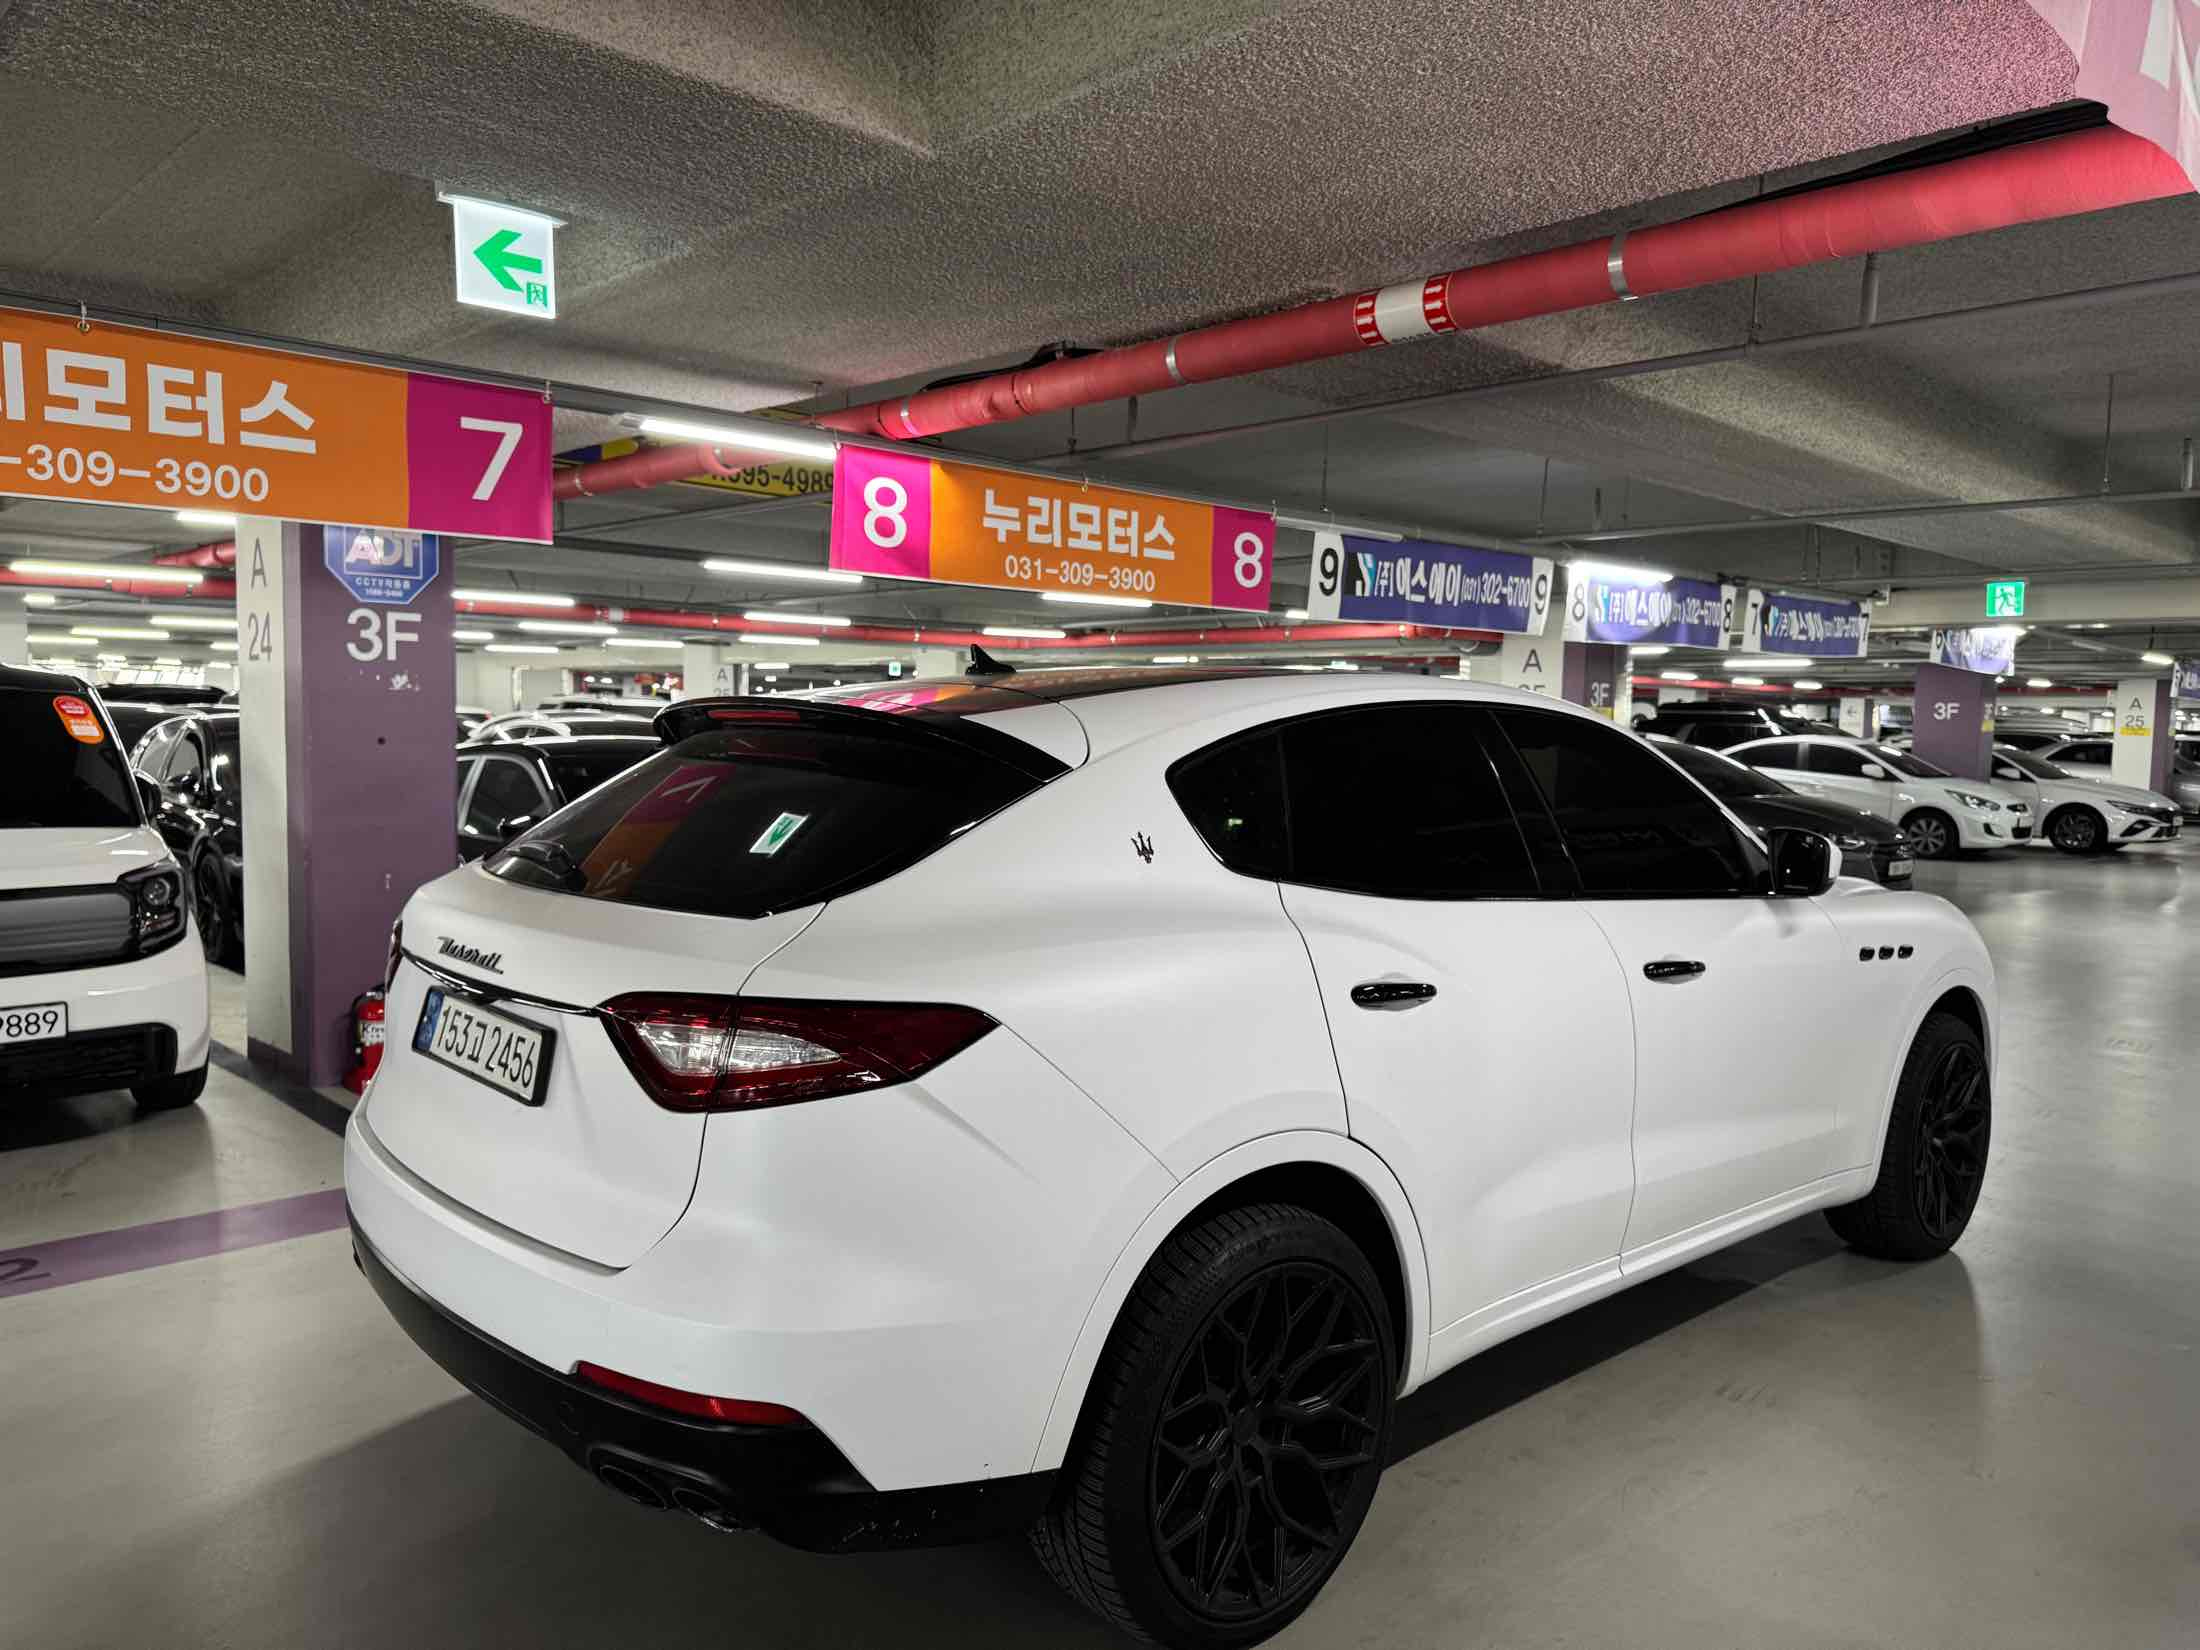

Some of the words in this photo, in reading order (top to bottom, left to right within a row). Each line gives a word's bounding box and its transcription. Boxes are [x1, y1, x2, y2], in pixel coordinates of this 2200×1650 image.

[460, 416, 524, 501] 7
[863, 476, 908, 548] 8
[982, 488, 1176, 561] 누리모터스
[1233, 531, 1264, 588] 8
[250, 537, 268, 590] A
[1004, 554, 1156, 592] 031-309-3900
[1319, 547, 1339, 597] 9
[1534, 573, 1549, 616] 9
[1572, 583, 1585, 622] 8
[1722, 598, 1733, 633] 8
[247, 611, 273, 662] 24
[346, 607, 422, 662] 3F
[716, 666, 728, 681] A
[1522, 648, 1543, 673] A
[1590, 681, 1610, 707] 3F
[1933, 702, 1961, 721] 3F
[2129, 697, 2142, 710] A
[2125, 714, 2145, 728] 25
[0, 1009, 59, 1038] 889
[484, 1025, 536, 1089] 2456
